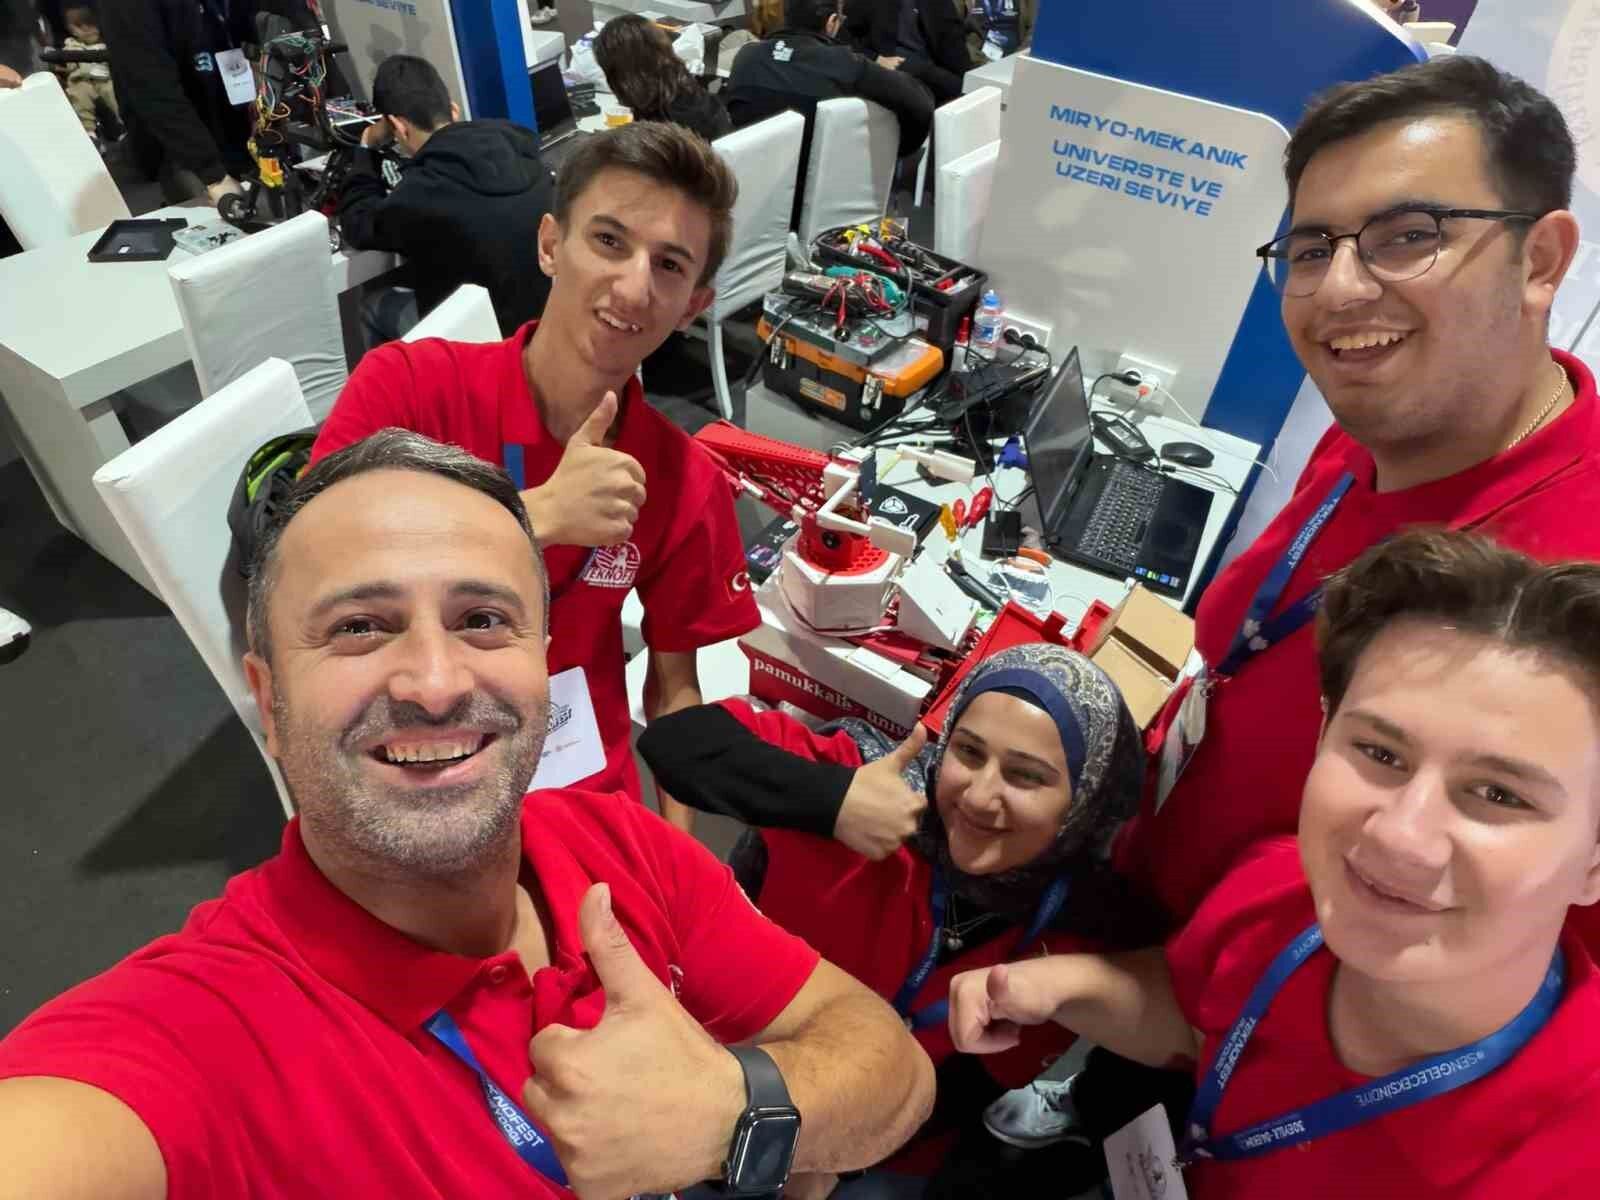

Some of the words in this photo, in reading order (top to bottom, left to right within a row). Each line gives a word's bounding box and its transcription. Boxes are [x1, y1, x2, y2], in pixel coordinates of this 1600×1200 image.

[1050, 104, 1248, 169] MIRYO-MEKANIK
[1053, 139, 1184, 188] UNIVERSTE
[1190, 175, 1223, 198] VE
[1056, 161, 1121, 191] UZERI
[1123, 180, 1213, 216] SEVIYE
[487, 1083, 545, 1147] NOFEST
